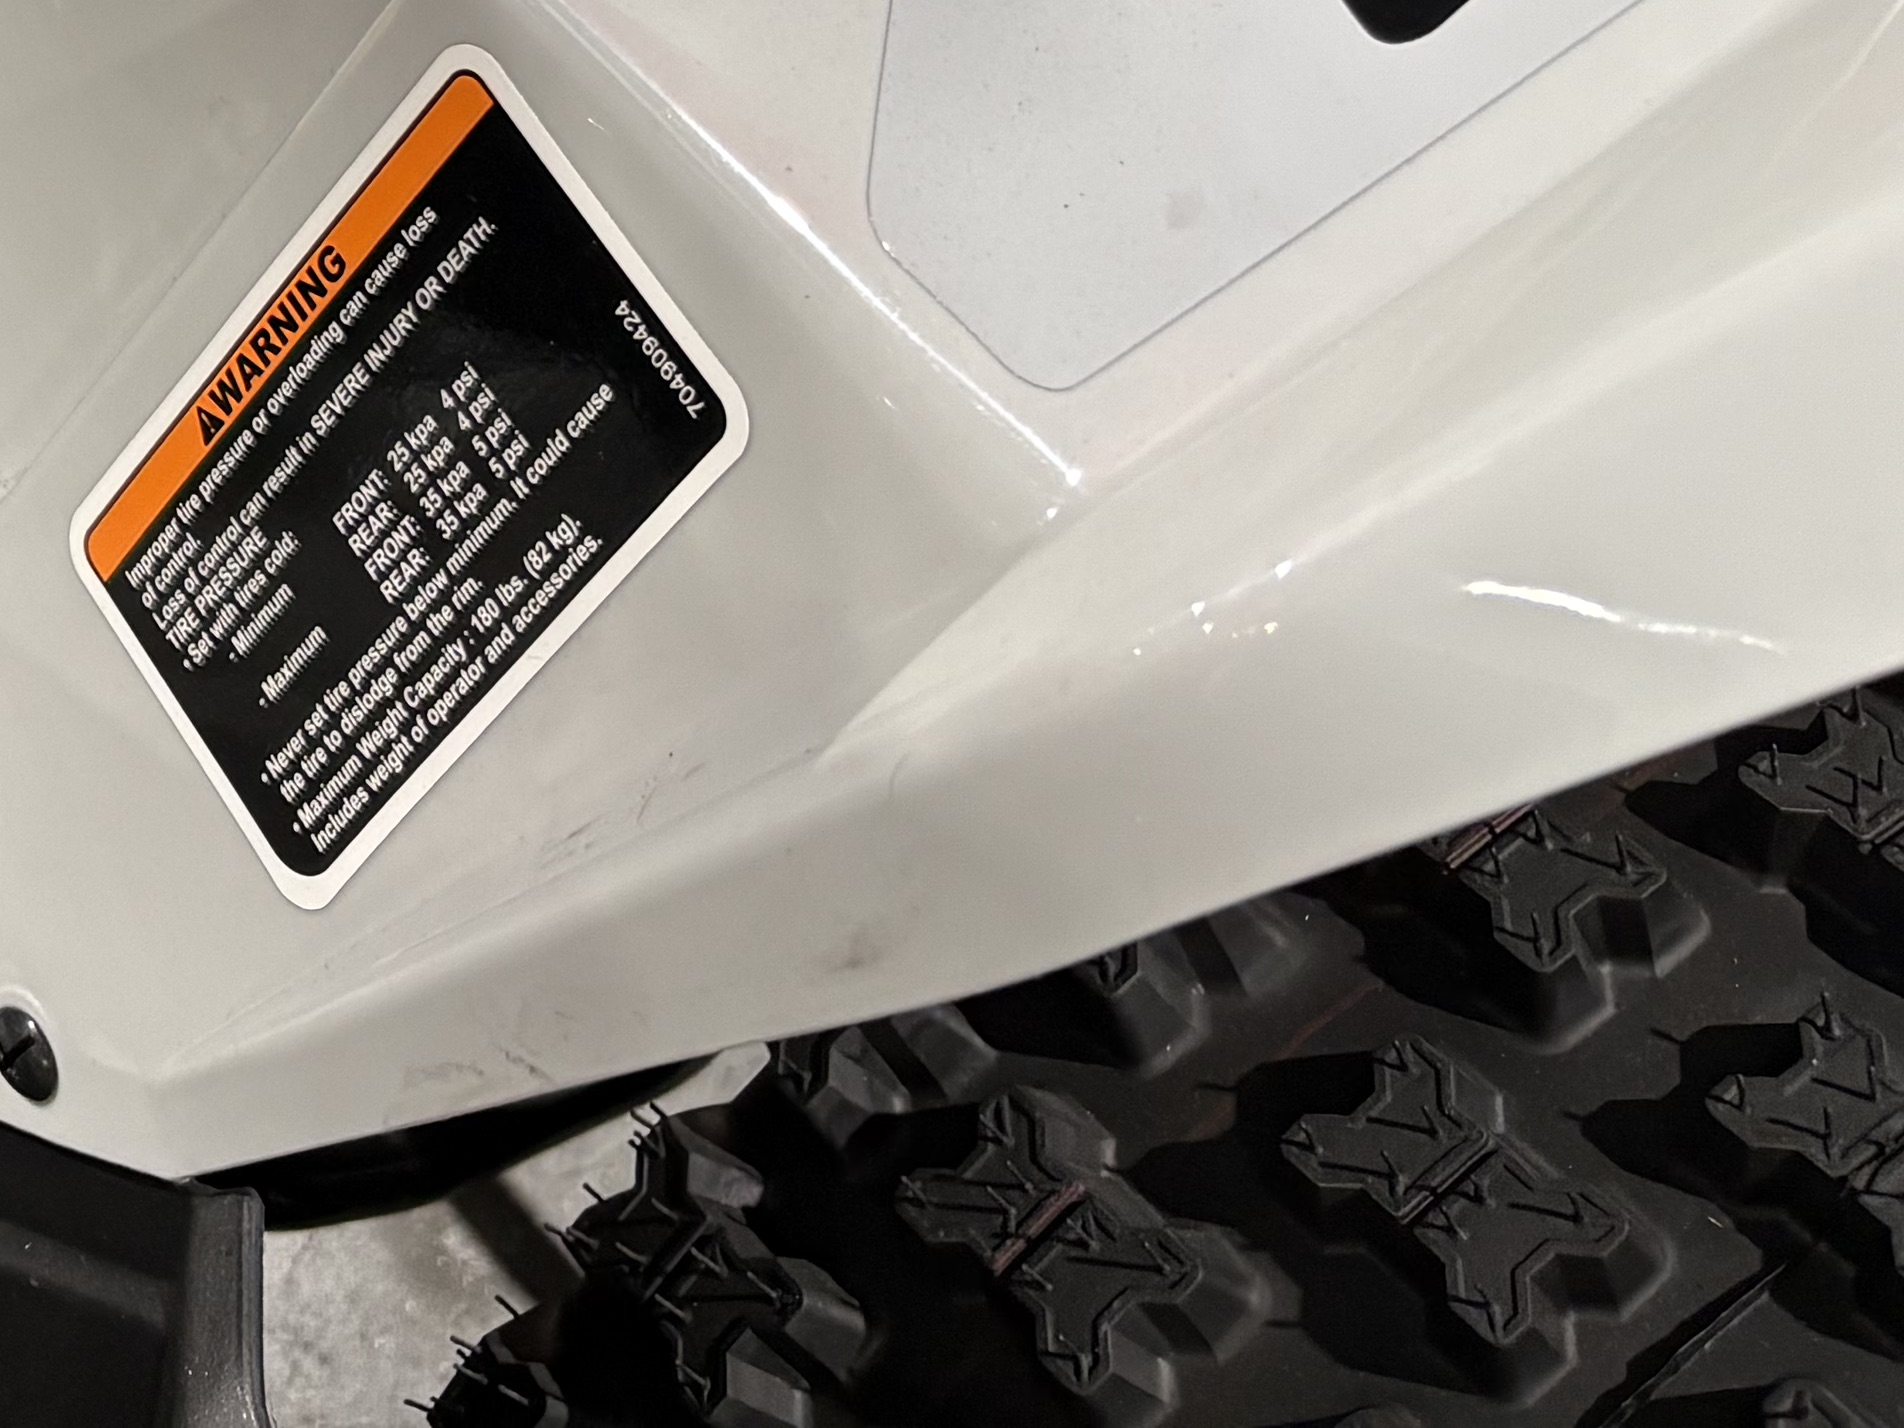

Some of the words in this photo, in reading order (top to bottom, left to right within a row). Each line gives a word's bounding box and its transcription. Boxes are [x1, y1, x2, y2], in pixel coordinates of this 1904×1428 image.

[123, 516, 182, 588] Improper
[175, 492, 202, 525] tire
[197, 428, 254, 503] pressure
[250, 407, 269, 434] or
[266, 320, 344, 415] overloading
[338, 290, 368, 326] can
[363, 242, 407, 295] cause
[399, 205, 437, 247] loss
[208, 245, 348, 416] WARNING
[613, 298, 705, 419] 704909424
[151, 588, 188, 631] Loss
[182, 565, 201, 595] of
[196, 515, 244, 578] control
[238, 491, 266, 526] can
[261, 444, 303, 498] result
[294, 430, 317, 454] in
[309, 361, 370, 436] SEVERE
[362, 300, 418, 372] INJURY
[414, 275, 444, 310] OR
[435, 215, 496, 283] DEATH.
[331, 467, 389, 535] FRONT:
[385, 439, 410, 472] 25
[402, 413, 439, 450] kpa
[439, 388, 455, 409] 4
[450, 360, 479, 402] psi
[346, 499, 398, 557] REAR:
[402, 461, 427, 493] 25
[419, 435, 454, 472] kpa
[456, 409, 472, 431] 4
[467, 382, 496, 424] psi
[362, 513, 421, 581] FRONT:
[418, 485, 443, 517] 35
[435, 460, 471, 497] kpa
[470, 433, 488, 457] 5
[483, 406, 512, 449] psi
[140, 580, 158, 609] of
[148, 531, 201, 593] control.
[164, 605, 201, 650] TIRE
[193, 524, 267, 617] PRESSURE
[186, 630, 216, 666] Set
[208, 601, 240, 640] with
[232, 568, 268, 609] tires
[263, 530, 299, 575] cold:
[264, 727, 307, 779] Never
[302, 702, 329, 736] set
[322, 679, 351, 713] tire
[347, 615, 408, 690] pressure
[401, 567, 449, 621] below
[445, 497, 518, 576] minimum.
[508, 475, 530, 499] It
[525, 427, 570, 485] could
[565, 383, 613, 438] cause
[378, 546, 430, 604] REAR:
[434, 507, 460, 540] 35
[452, 482, 487, 519] kpa
[487, 455, 505, 479] 5
[500, 428, 530, 471] psi
[229, 582, 295, 656] Minimum
[259, 625, 327, 702] Maximum
[278, 771, 306, 803] the
[299, 746, 328, 778] tire
[321, 728, 343, 753] to
[339, 666, 398, 735] dislodge
[391, 629, 432, 673] from
[424, 604, 454, 637] the
[450, 576, 483, 611] rim.
[295, 753, 363, 829] Maximum
[354, 699, 409, 759] Weight
[402, 636, 467, 708] Capacity
[469, 596, 501, 633] 180
[493, 574, 529, 607] lbs.
[521, 539, 552, 580] (82
[544, 512, 581, 550] kg).
[309, 785, 370, 853] Includes
[364, 733, 414, 792] weight
[409, 713, 429, 743] of
[425, 655, 486, 726] operator
[483, 621, 516, 664] and
[511, 534, 603, 633] accessories.
